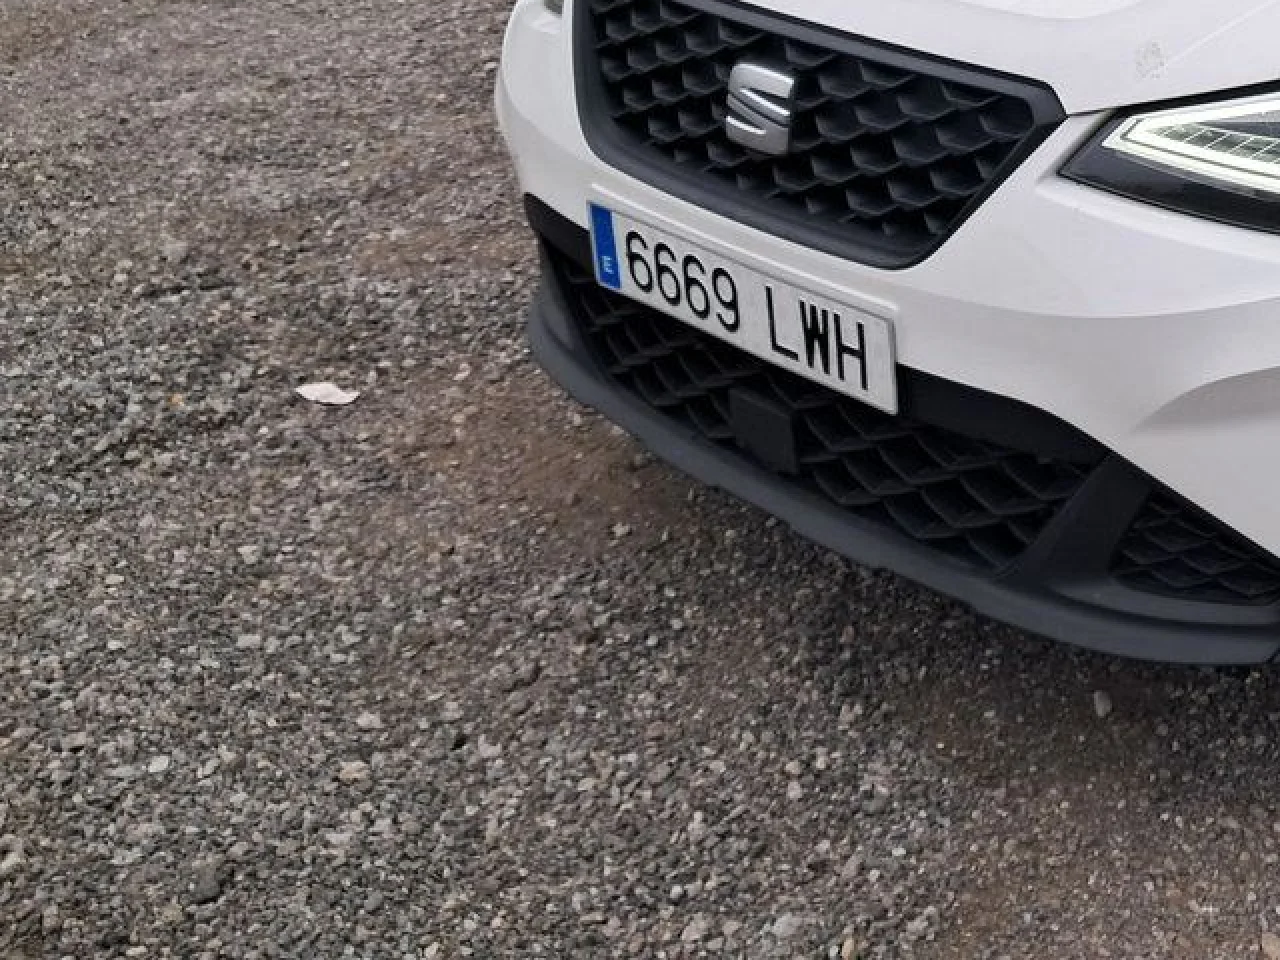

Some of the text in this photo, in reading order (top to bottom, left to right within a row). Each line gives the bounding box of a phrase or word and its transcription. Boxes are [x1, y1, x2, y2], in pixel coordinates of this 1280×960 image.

[601, 230, 869, 391] E 6669 LWH
